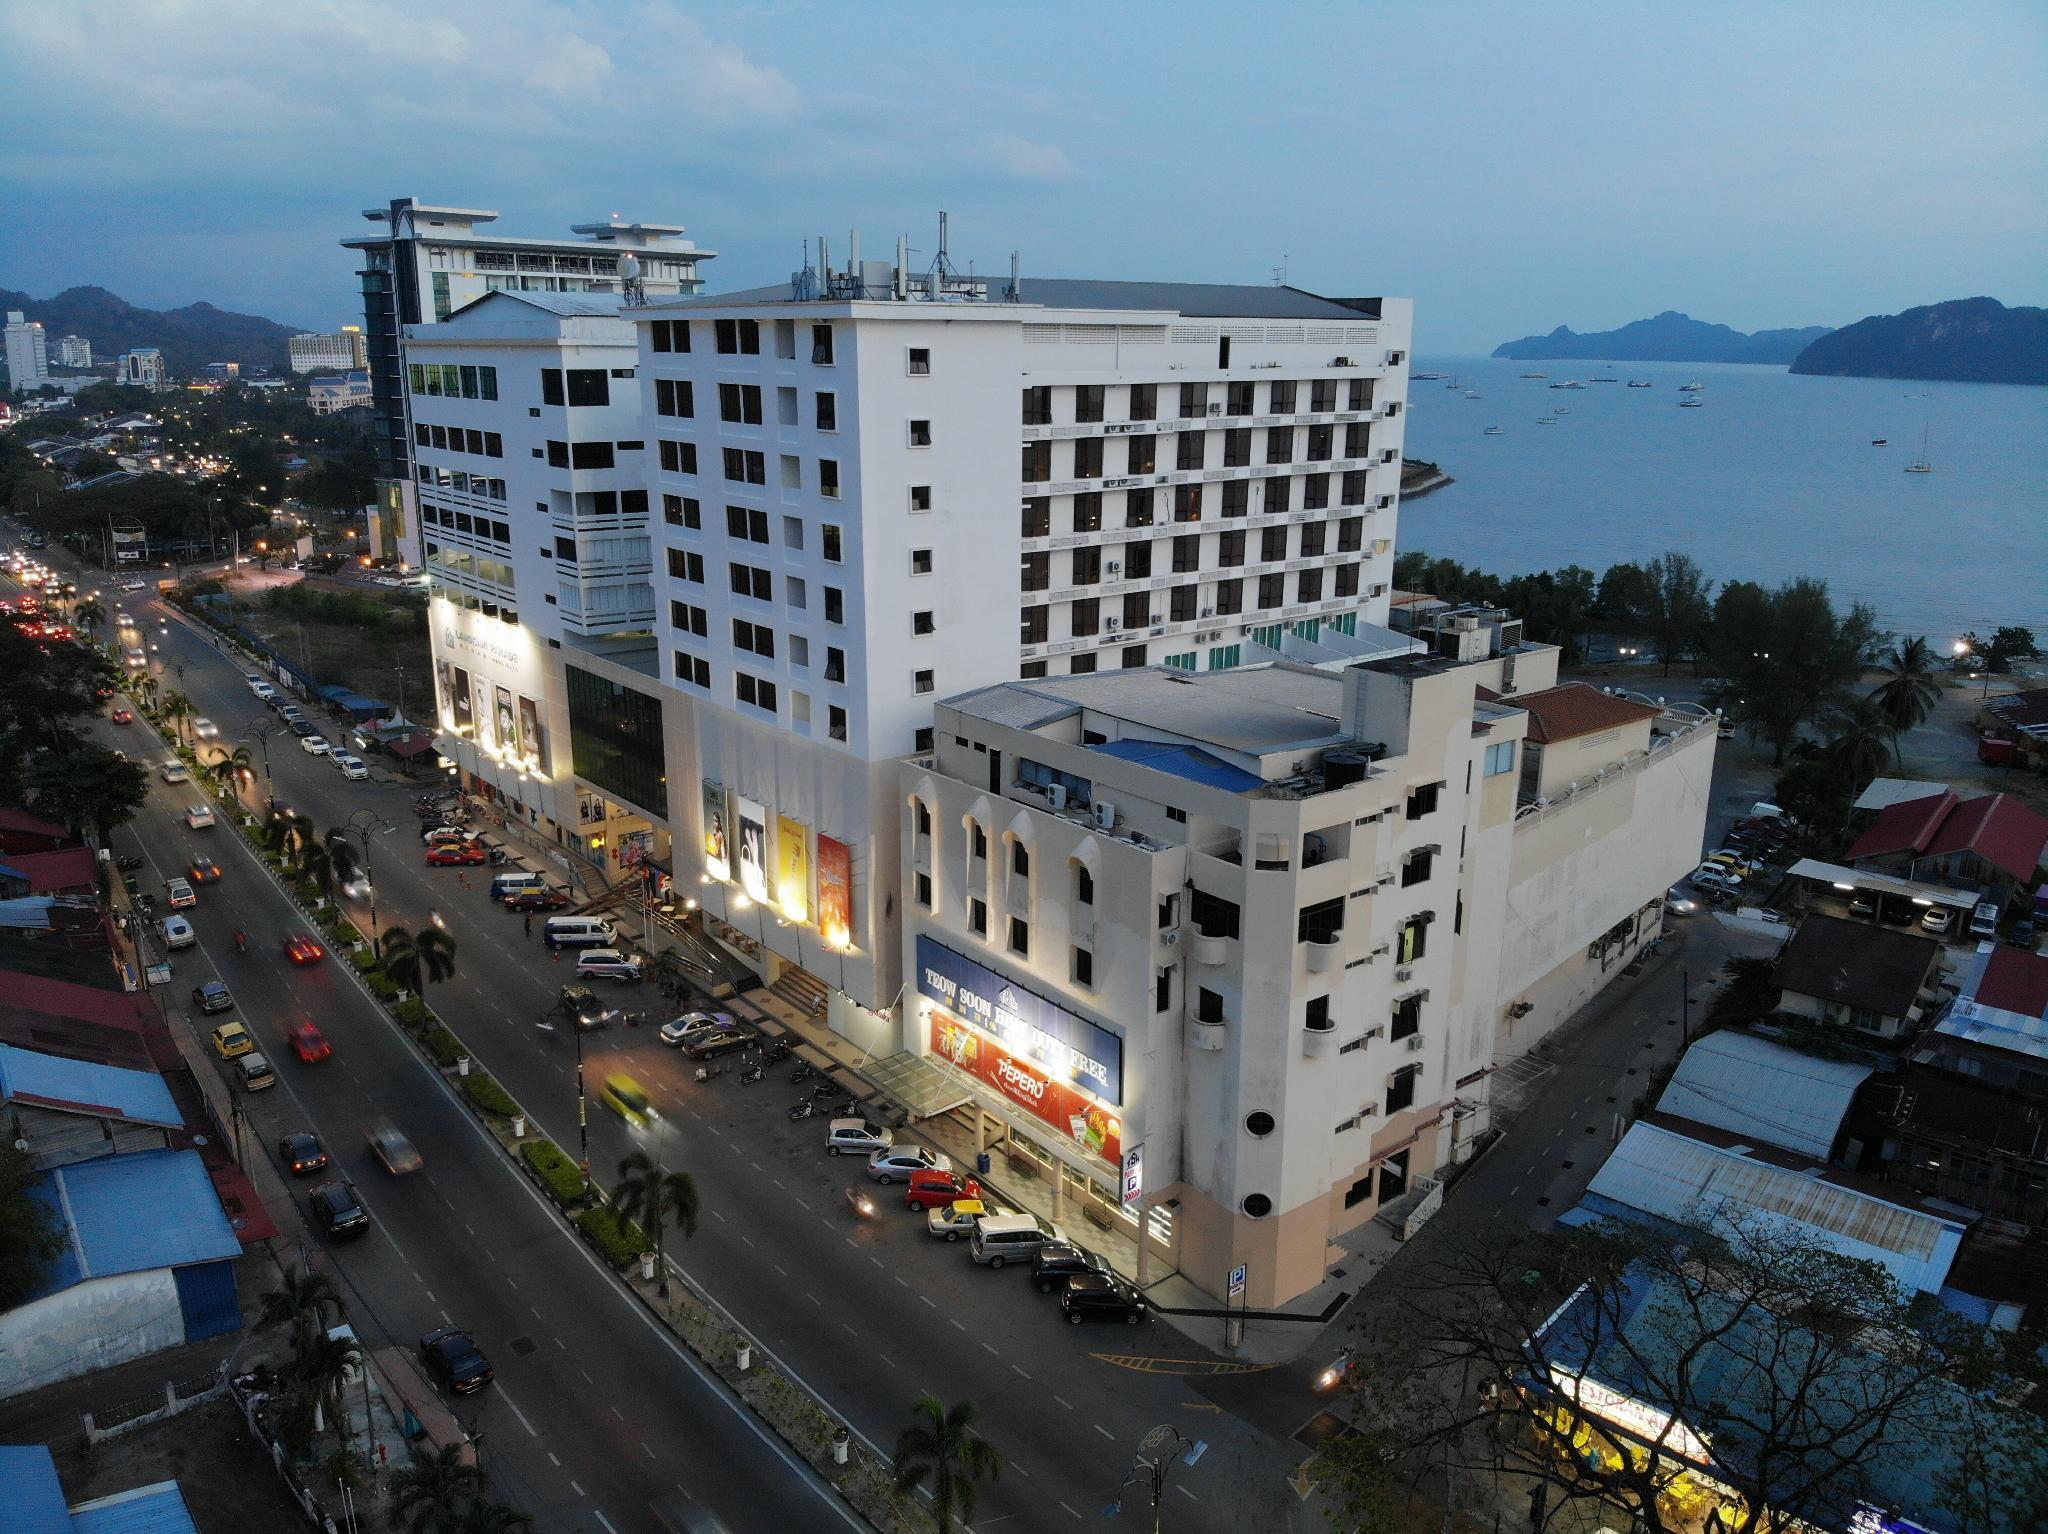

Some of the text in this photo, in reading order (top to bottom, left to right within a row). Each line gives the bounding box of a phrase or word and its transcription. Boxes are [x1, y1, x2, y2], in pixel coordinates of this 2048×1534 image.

[925, 968, 957, 998] TEOW
[959, 987, 992, 1018] SOON
[1070, 1047, 1107, 1082] FREE
[998, 1060, 1044, 1099] PEPERO
[1234, 1270, 1241, 1284] P
